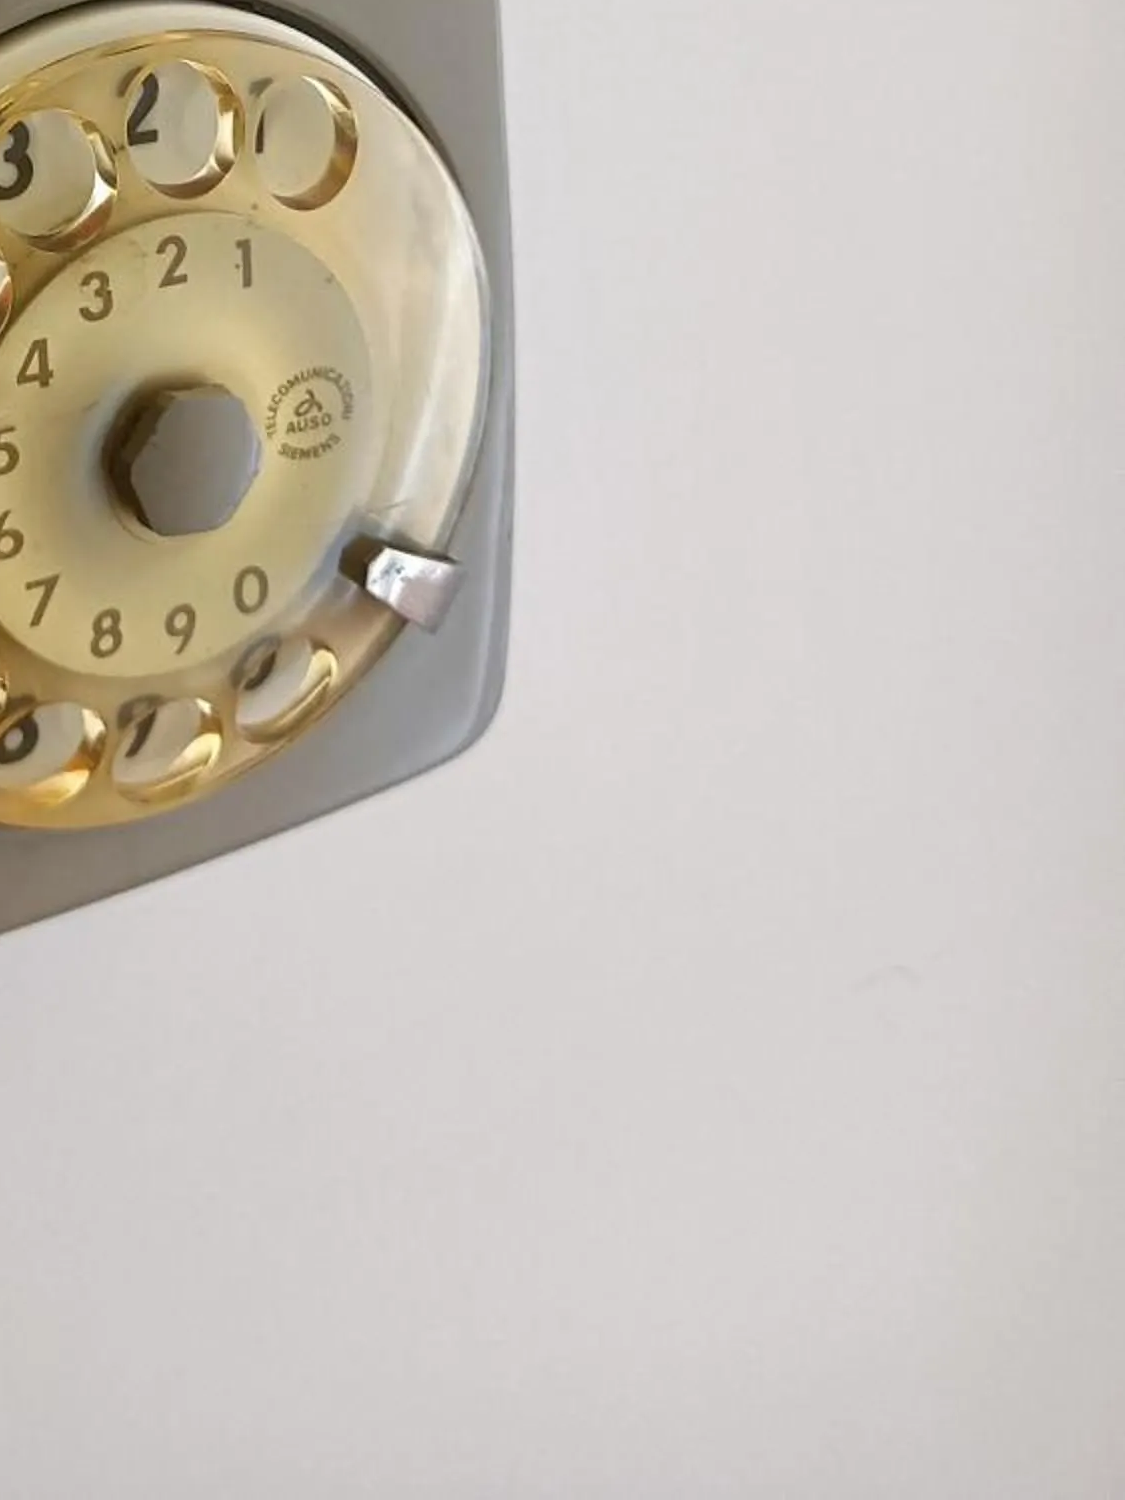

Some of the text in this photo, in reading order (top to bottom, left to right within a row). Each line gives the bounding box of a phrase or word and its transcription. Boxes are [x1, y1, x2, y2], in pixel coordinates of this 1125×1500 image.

[117, 66, 159, 147] 2
[156, 235, 188, 288] 2
[236, 239, 253, 288] 1
[79, 271, 113, 322] 3
[16, 337, 54, 388] 4
[277, 432, 342, 461] SIEMENS
[286, 413, 333, 435] AUSO
[24, 573, 60, 628] 7
[233, 565, 269, 614] 0
[90, 608, 123, 659] 8
[165, 603, 196, 655] 9
